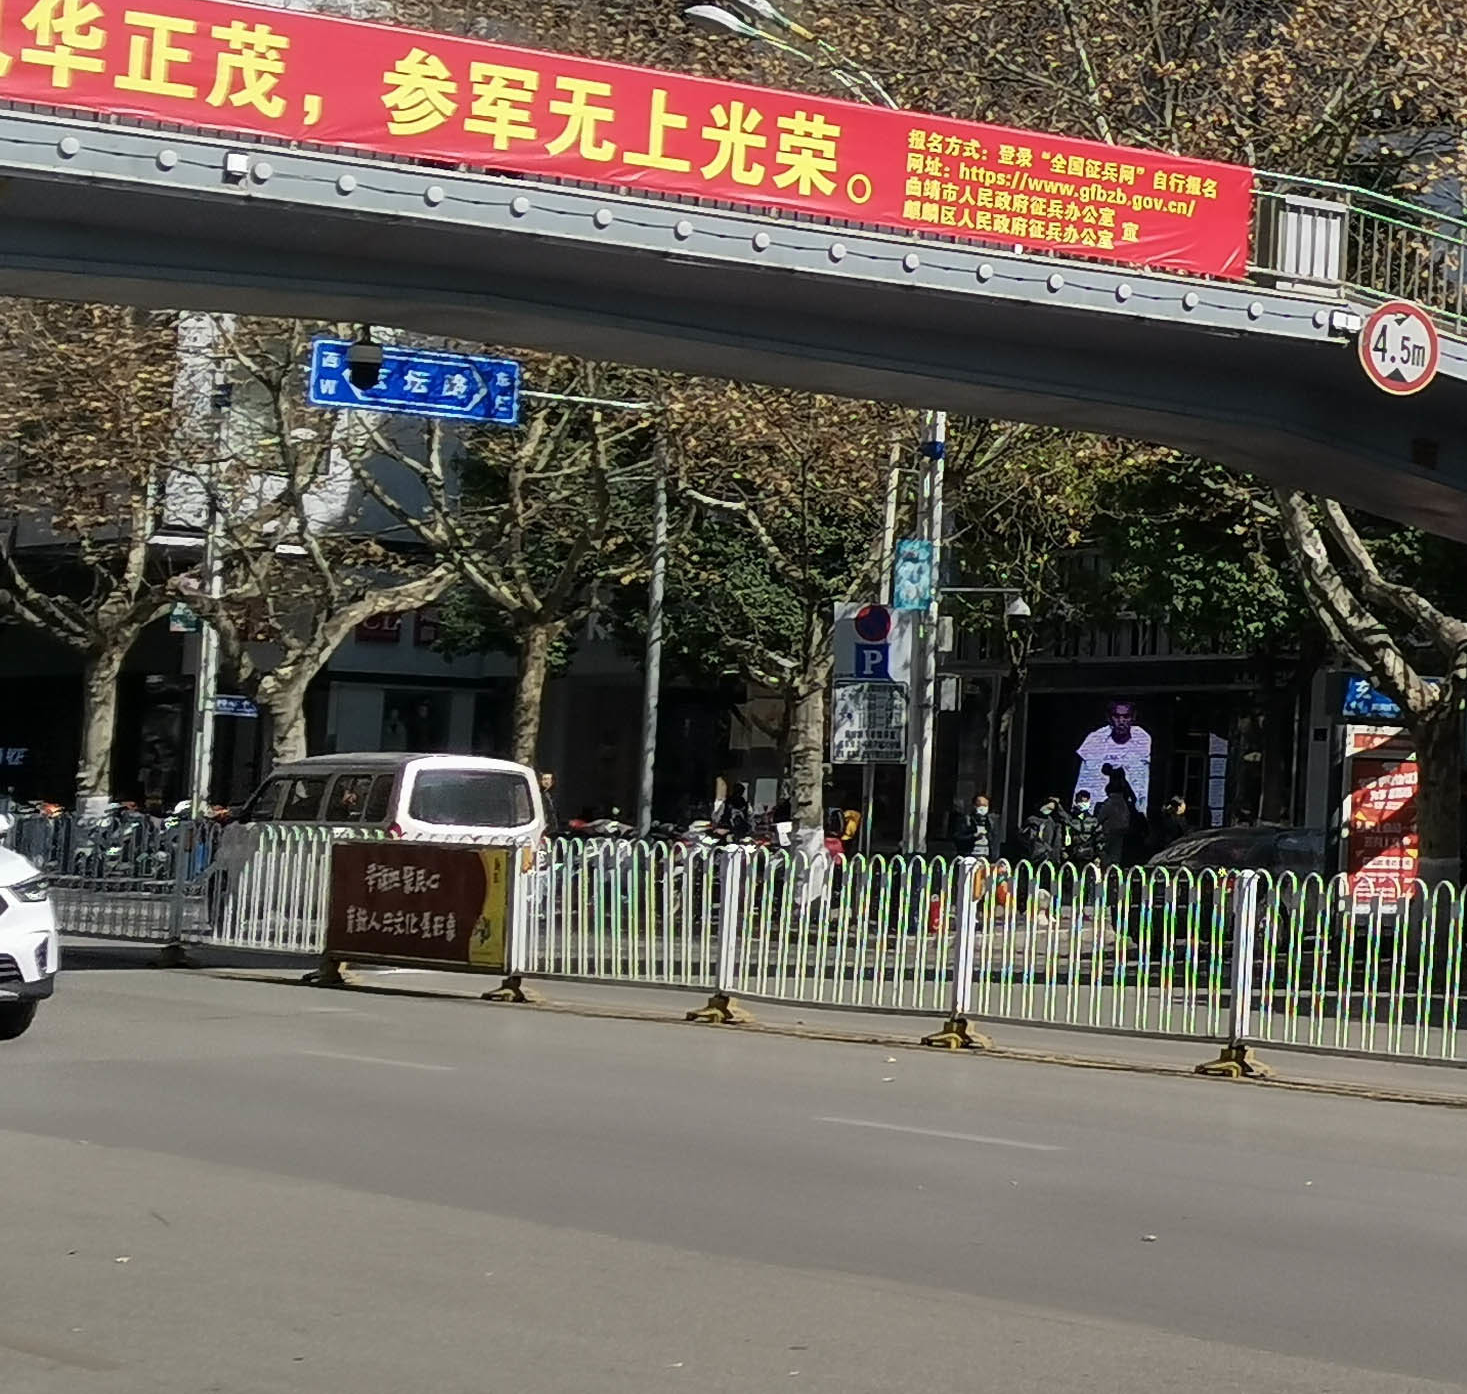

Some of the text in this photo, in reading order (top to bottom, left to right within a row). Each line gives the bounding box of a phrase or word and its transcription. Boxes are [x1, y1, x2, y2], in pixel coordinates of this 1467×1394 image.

[905, 177, 1116, 228] 曲靖市人民政府征兵办公室
[903, 200, 1115, 250] 麒麟区人民政府征兵办公室
[1121, 222, 1140, 243] 宣
[1373, 324, 1426, 367] 4.5m
[321, 351, 340, 369] 西
[319, 378, 338, 396] W
[863, 649, 883, 675] P
